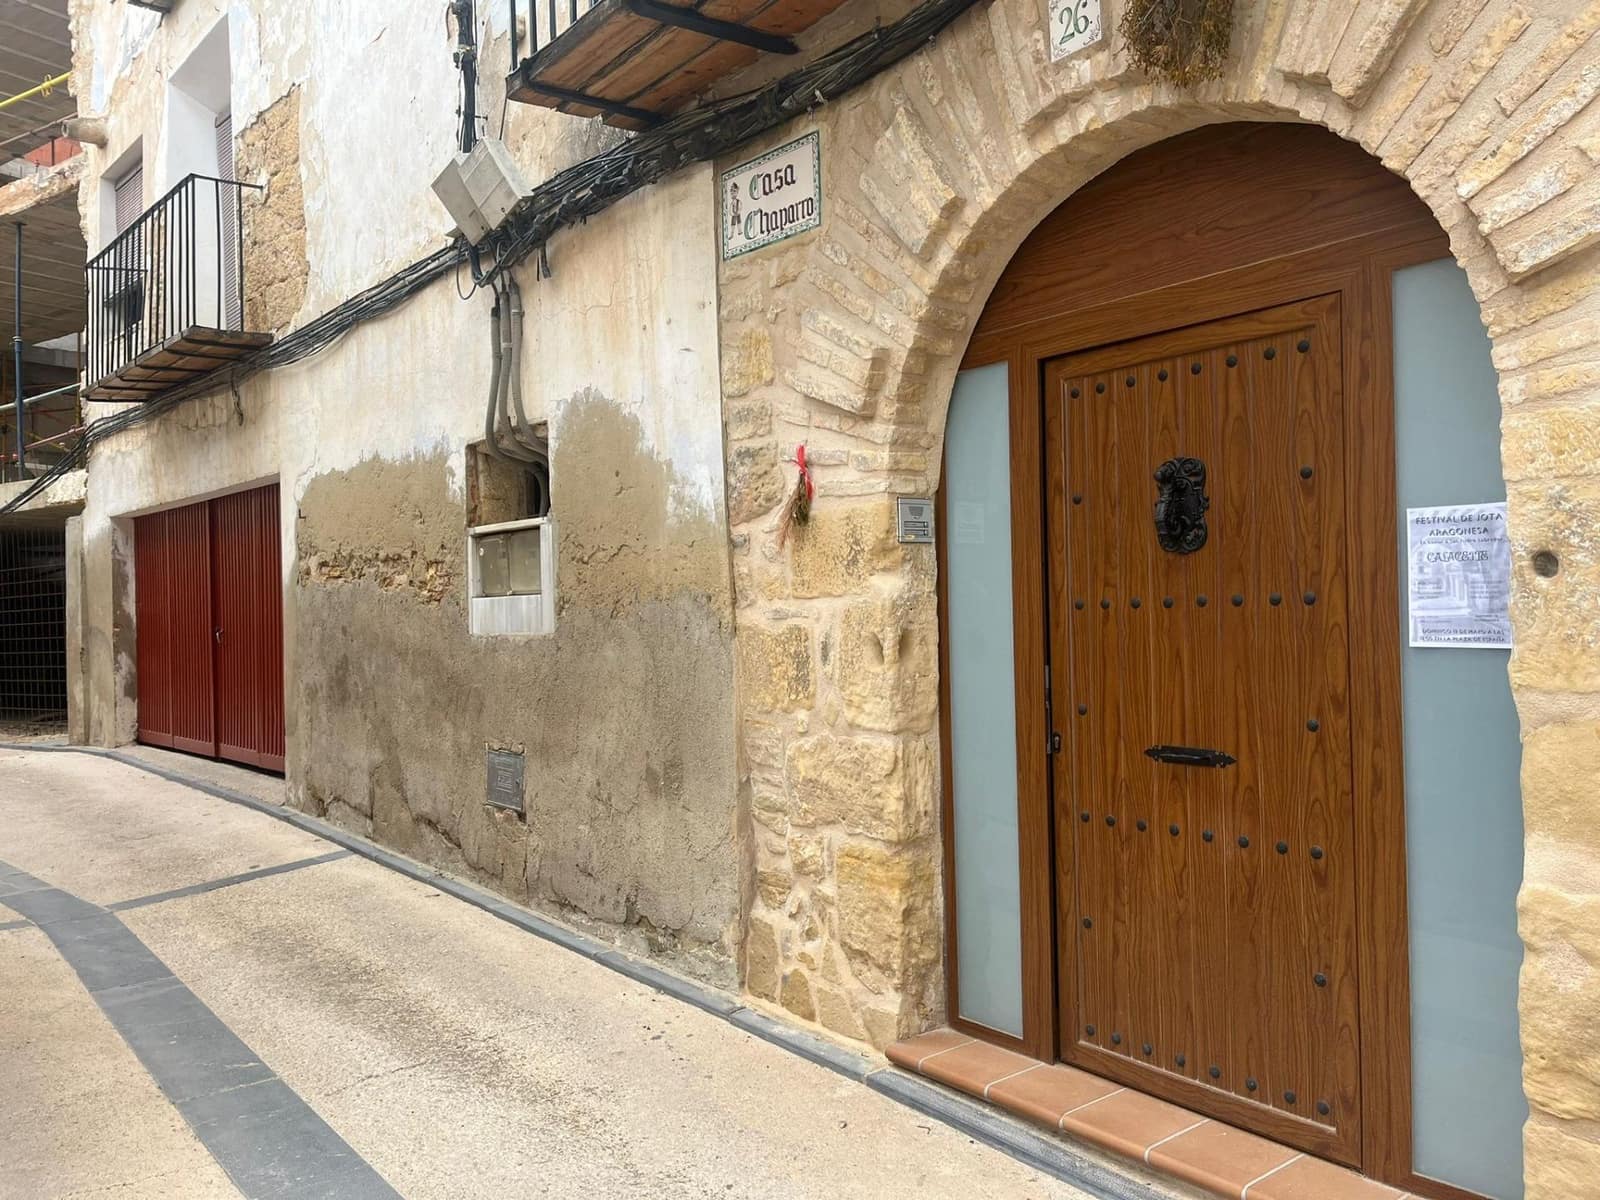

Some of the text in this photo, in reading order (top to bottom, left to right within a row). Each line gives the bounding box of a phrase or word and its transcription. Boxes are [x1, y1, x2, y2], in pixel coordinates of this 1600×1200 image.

[749, 164, 796, 200] Casa
[744, 197, 814, 240] Chaparro
[1415, 513, 1504, 525] FESTIVAL DE JOTA
[1429, 527, 1489, 536] ARAGONESA
